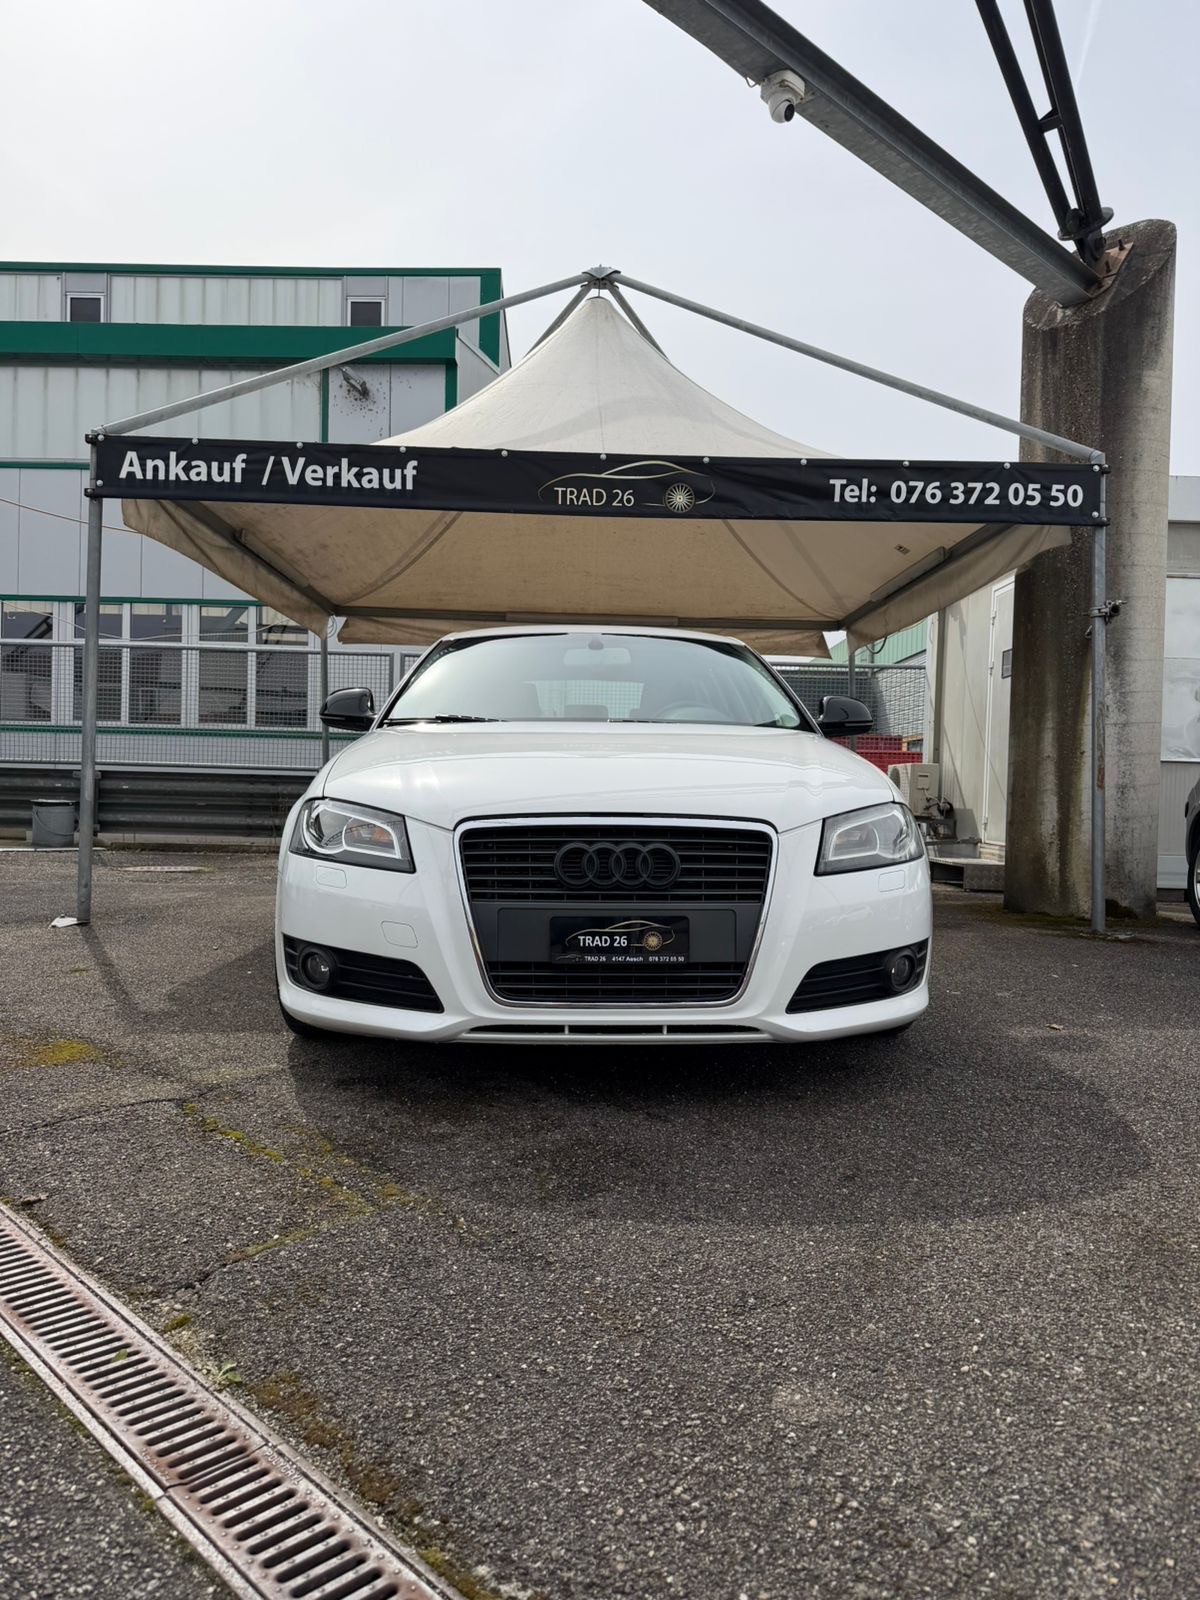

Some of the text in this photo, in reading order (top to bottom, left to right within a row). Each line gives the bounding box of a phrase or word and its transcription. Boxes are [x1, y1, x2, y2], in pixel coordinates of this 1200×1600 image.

[118, 450, 248, 484] Ankauf
[553, 487, 635, 507] TRAD 26
[829, 478, 1084, 508] Tel: 076 372 05 50
[577, 935, 628, 947] TRAD 26
